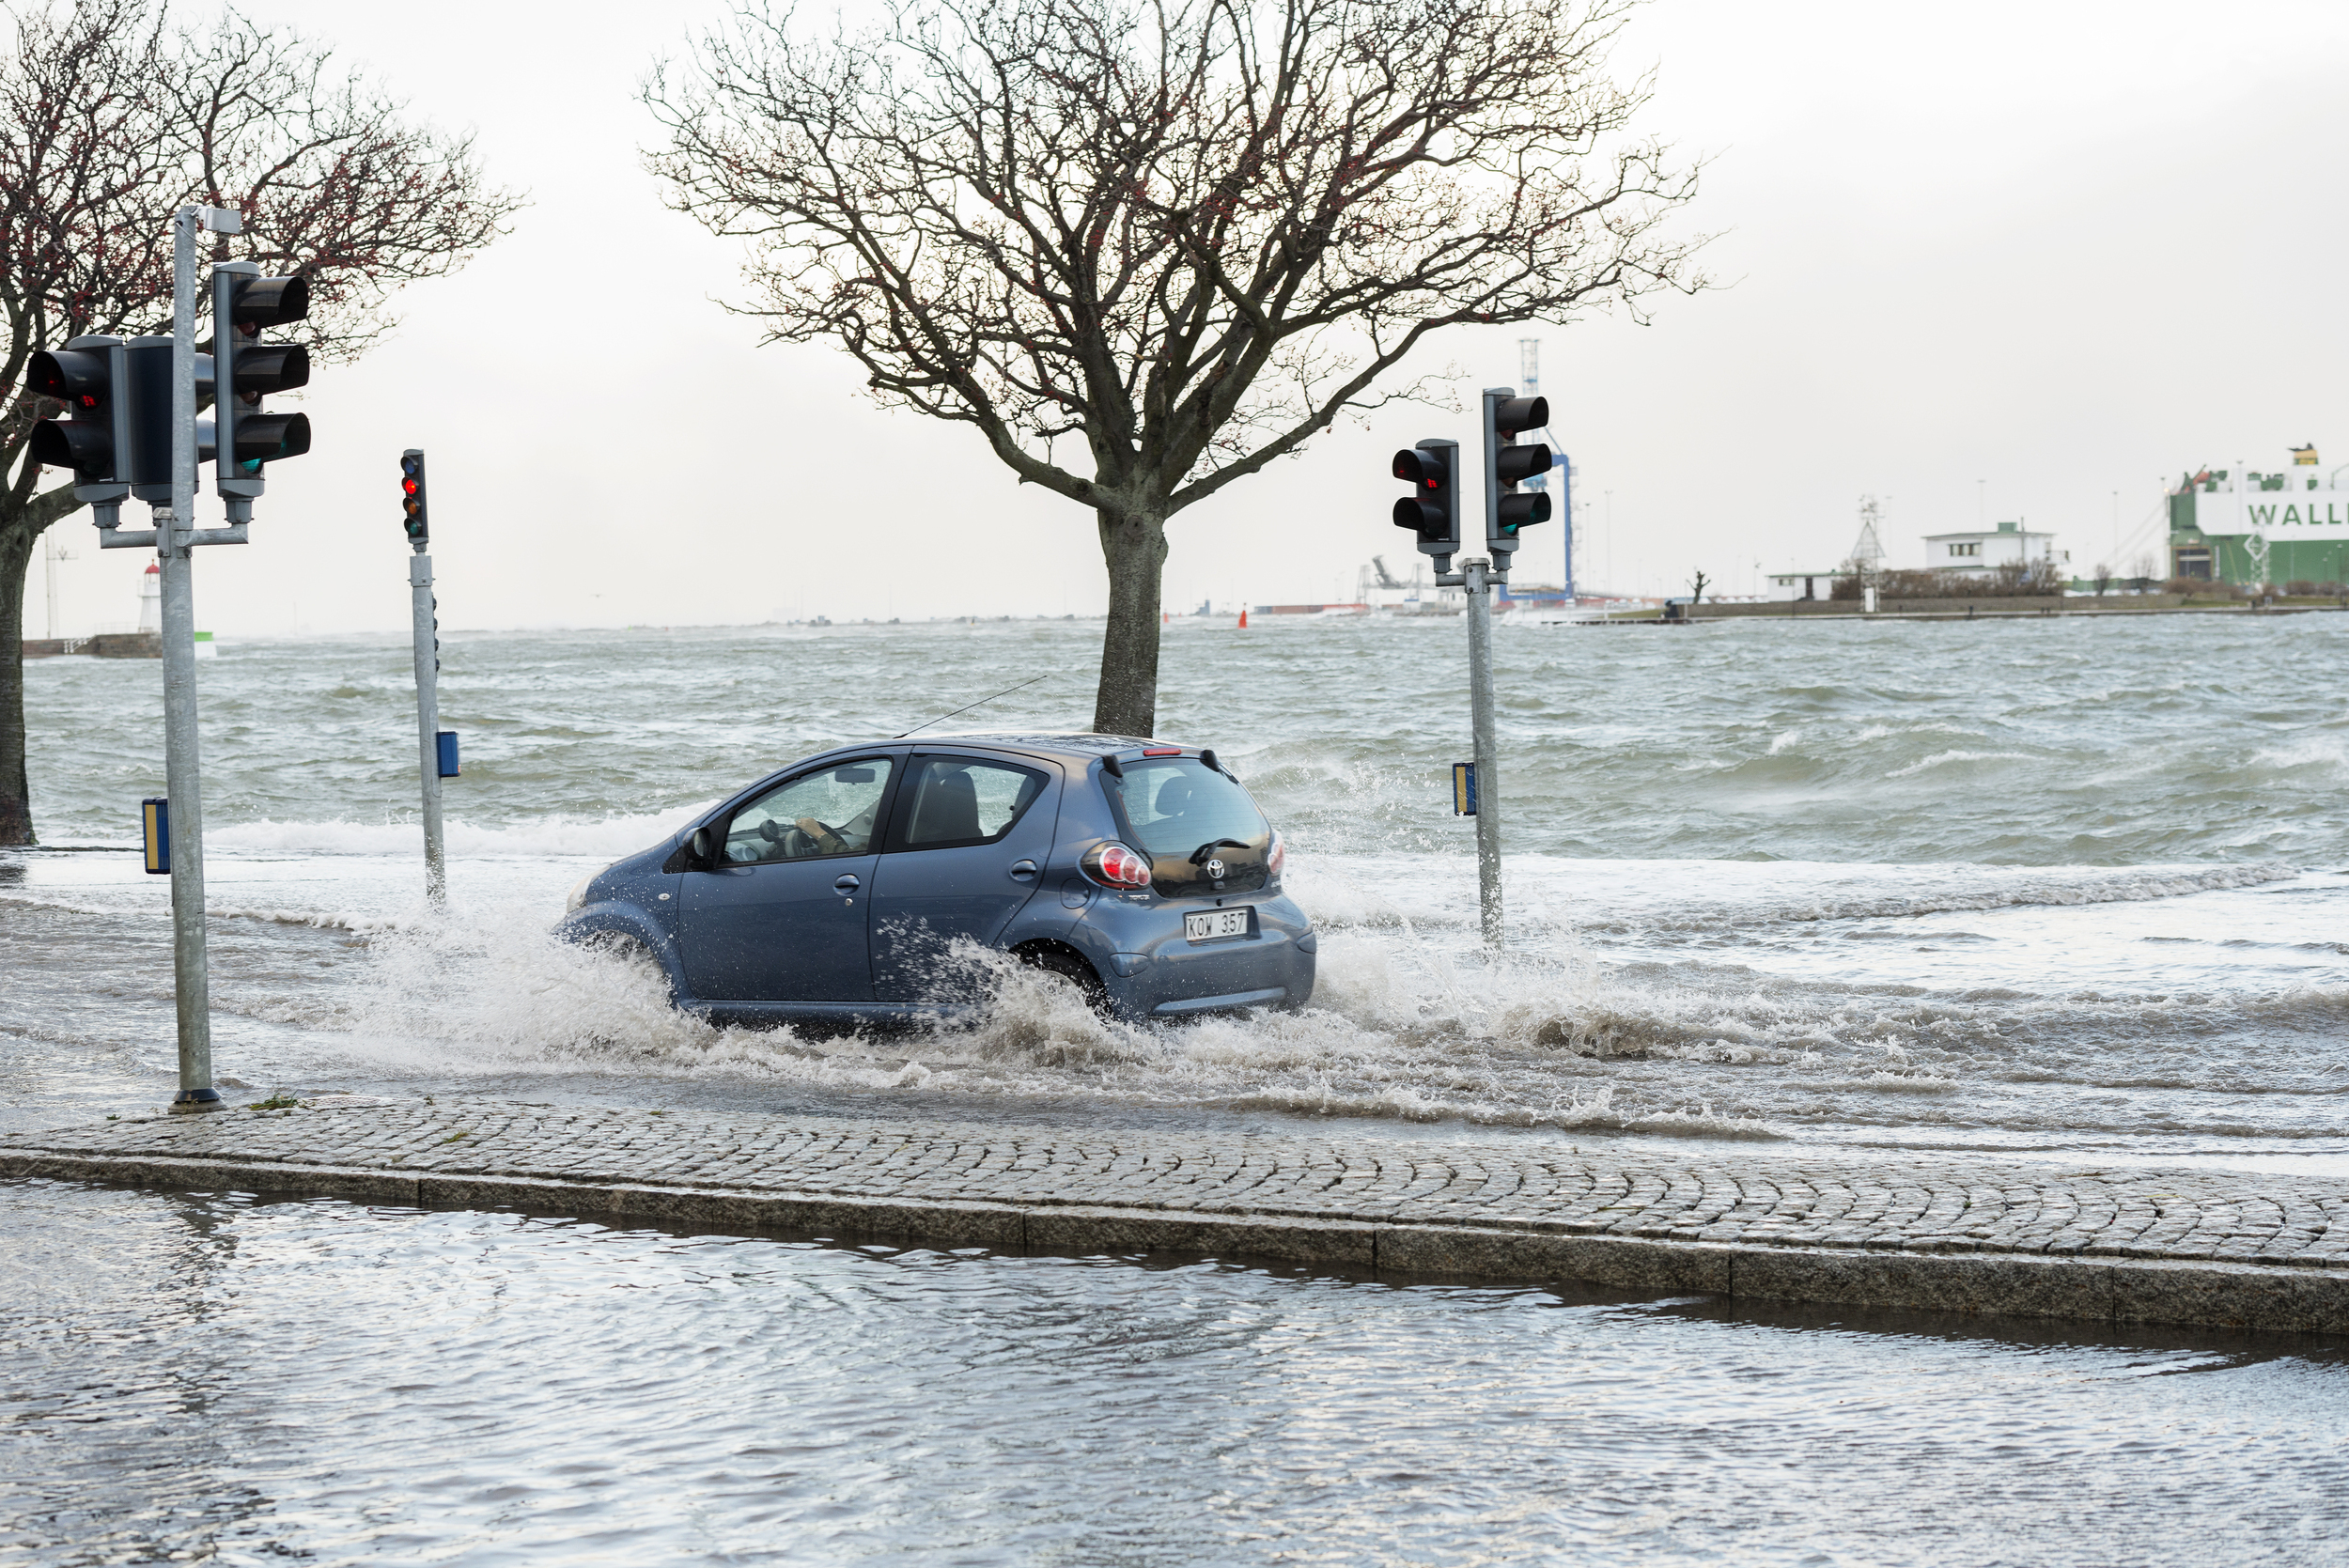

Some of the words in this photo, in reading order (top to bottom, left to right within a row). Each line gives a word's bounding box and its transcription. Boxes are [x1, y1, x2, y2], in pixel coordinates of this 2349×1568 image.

[2248, 503, 2349, 525] WALL
[1188, 916, 1212, 938] KOW
[1221, 912, 1247, 933] 357
